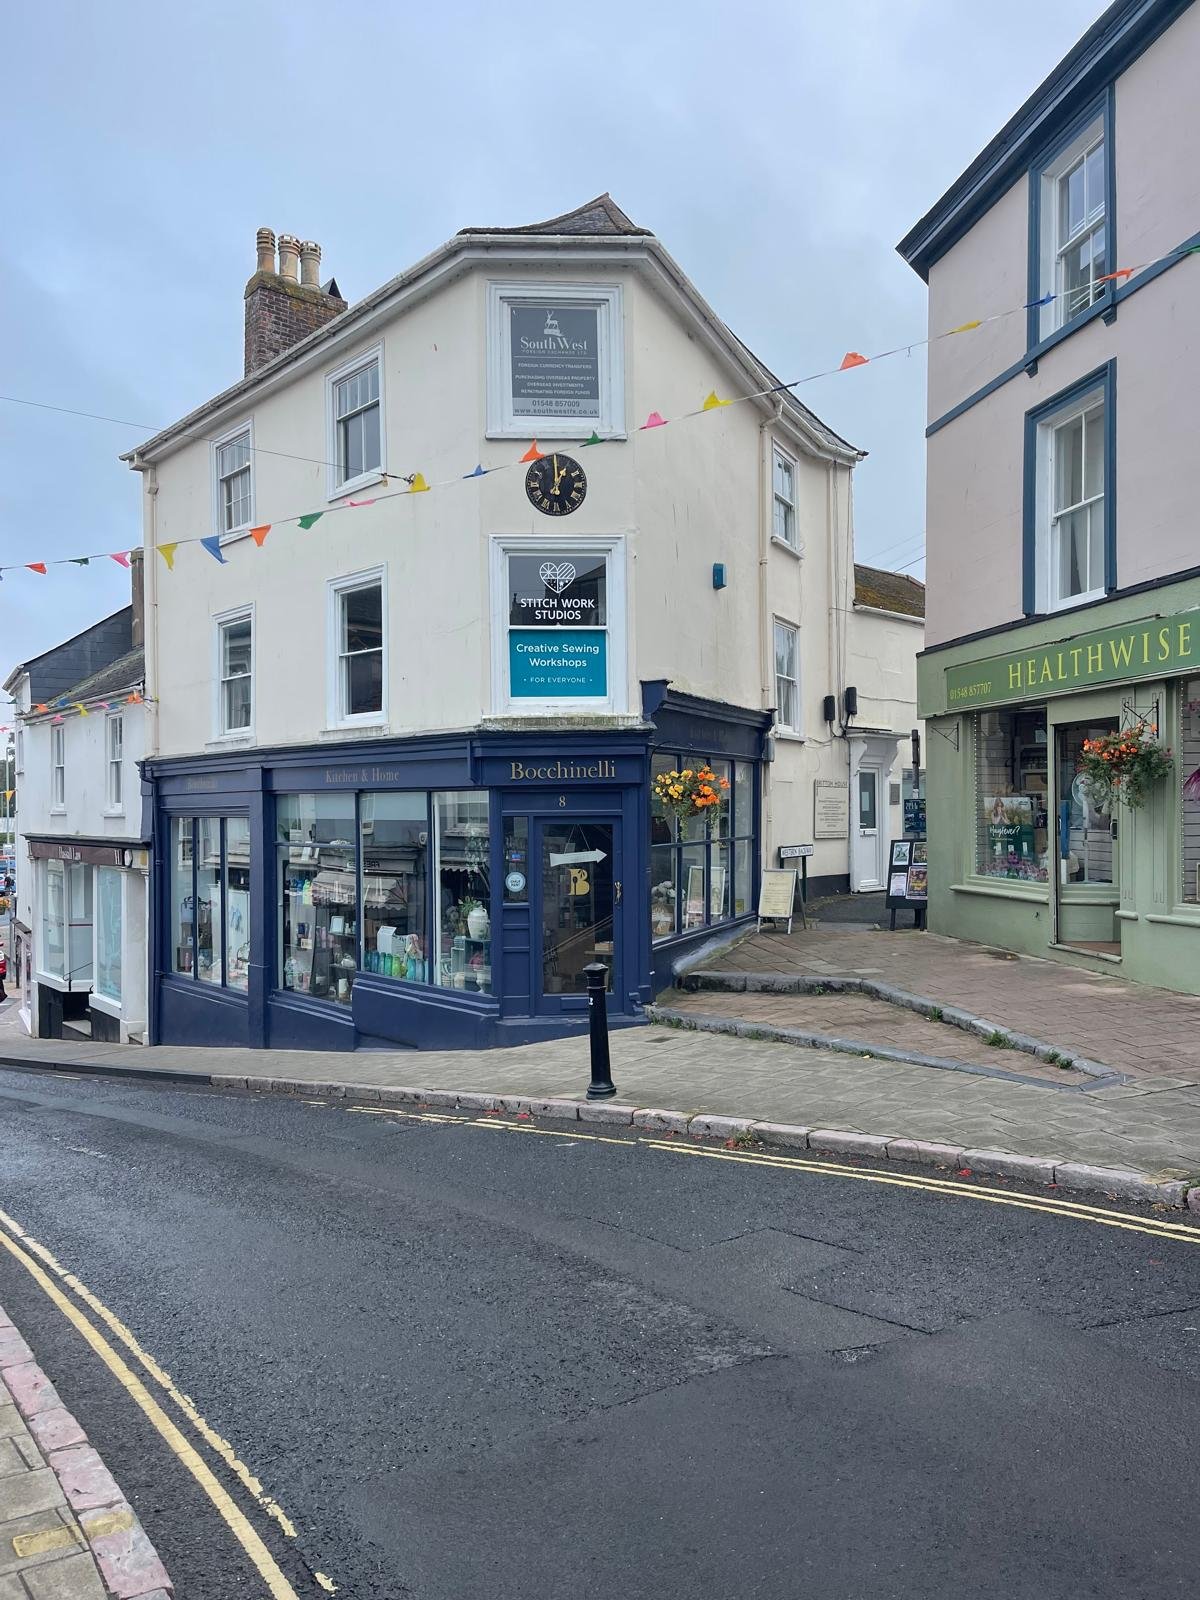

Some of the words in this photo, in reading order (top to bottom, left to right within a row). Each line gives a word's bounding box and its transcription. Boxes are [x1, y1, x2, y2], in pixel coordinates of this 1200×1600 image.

[520, 598, 558, 608] STITCH
[560, 598, 595, 608] WORK
[535, 610, 582, 620] STUDIOS
[516, 643, 560, 653] Creative
[562, 644, 600, 655] Sewing
[1007, 622, 1192, 689] HEALTHWISE
[529, 658, 588, 668] Workshops
[949, 686, 968, 700] 01548
[326, 768, 358, 783] Kitchen
[361, 768, 369, 782] &
[372, 767, 400, 782] Home
[510, 760, 616, 780] Bocchinelli
[559, 795, 566, 808] 8
